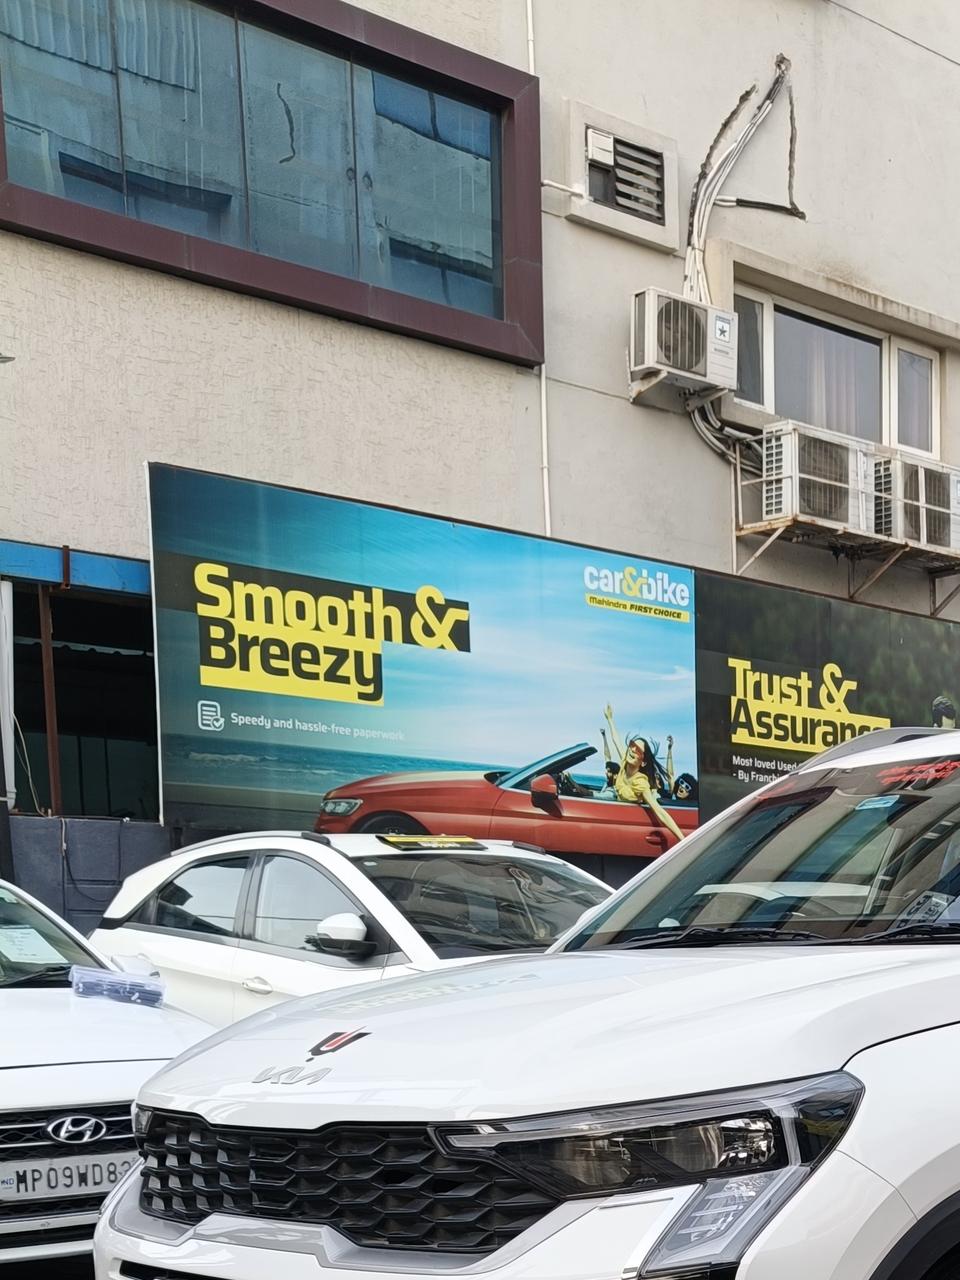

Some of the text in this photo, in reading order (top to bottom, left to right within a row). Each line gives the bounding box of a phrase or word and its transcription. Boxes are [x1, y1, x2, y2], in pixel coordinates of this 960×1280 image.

[194, 562, 470, 652] Smooth &
[583, 566, 690, 607] car&bike
[589, 596, 682, 619] Mahindra FIRST CHOICE
[198, 615, 383, 701] Breezy
[728, 657, 858, 714] Trust &
[230, 712, 405, 741] Speedy and hassle-free paperwork
[731, 698, 884, 748] Assuran
[732, 755, 797, 771] Most loved Used
[738, 769, 750, 783] By
